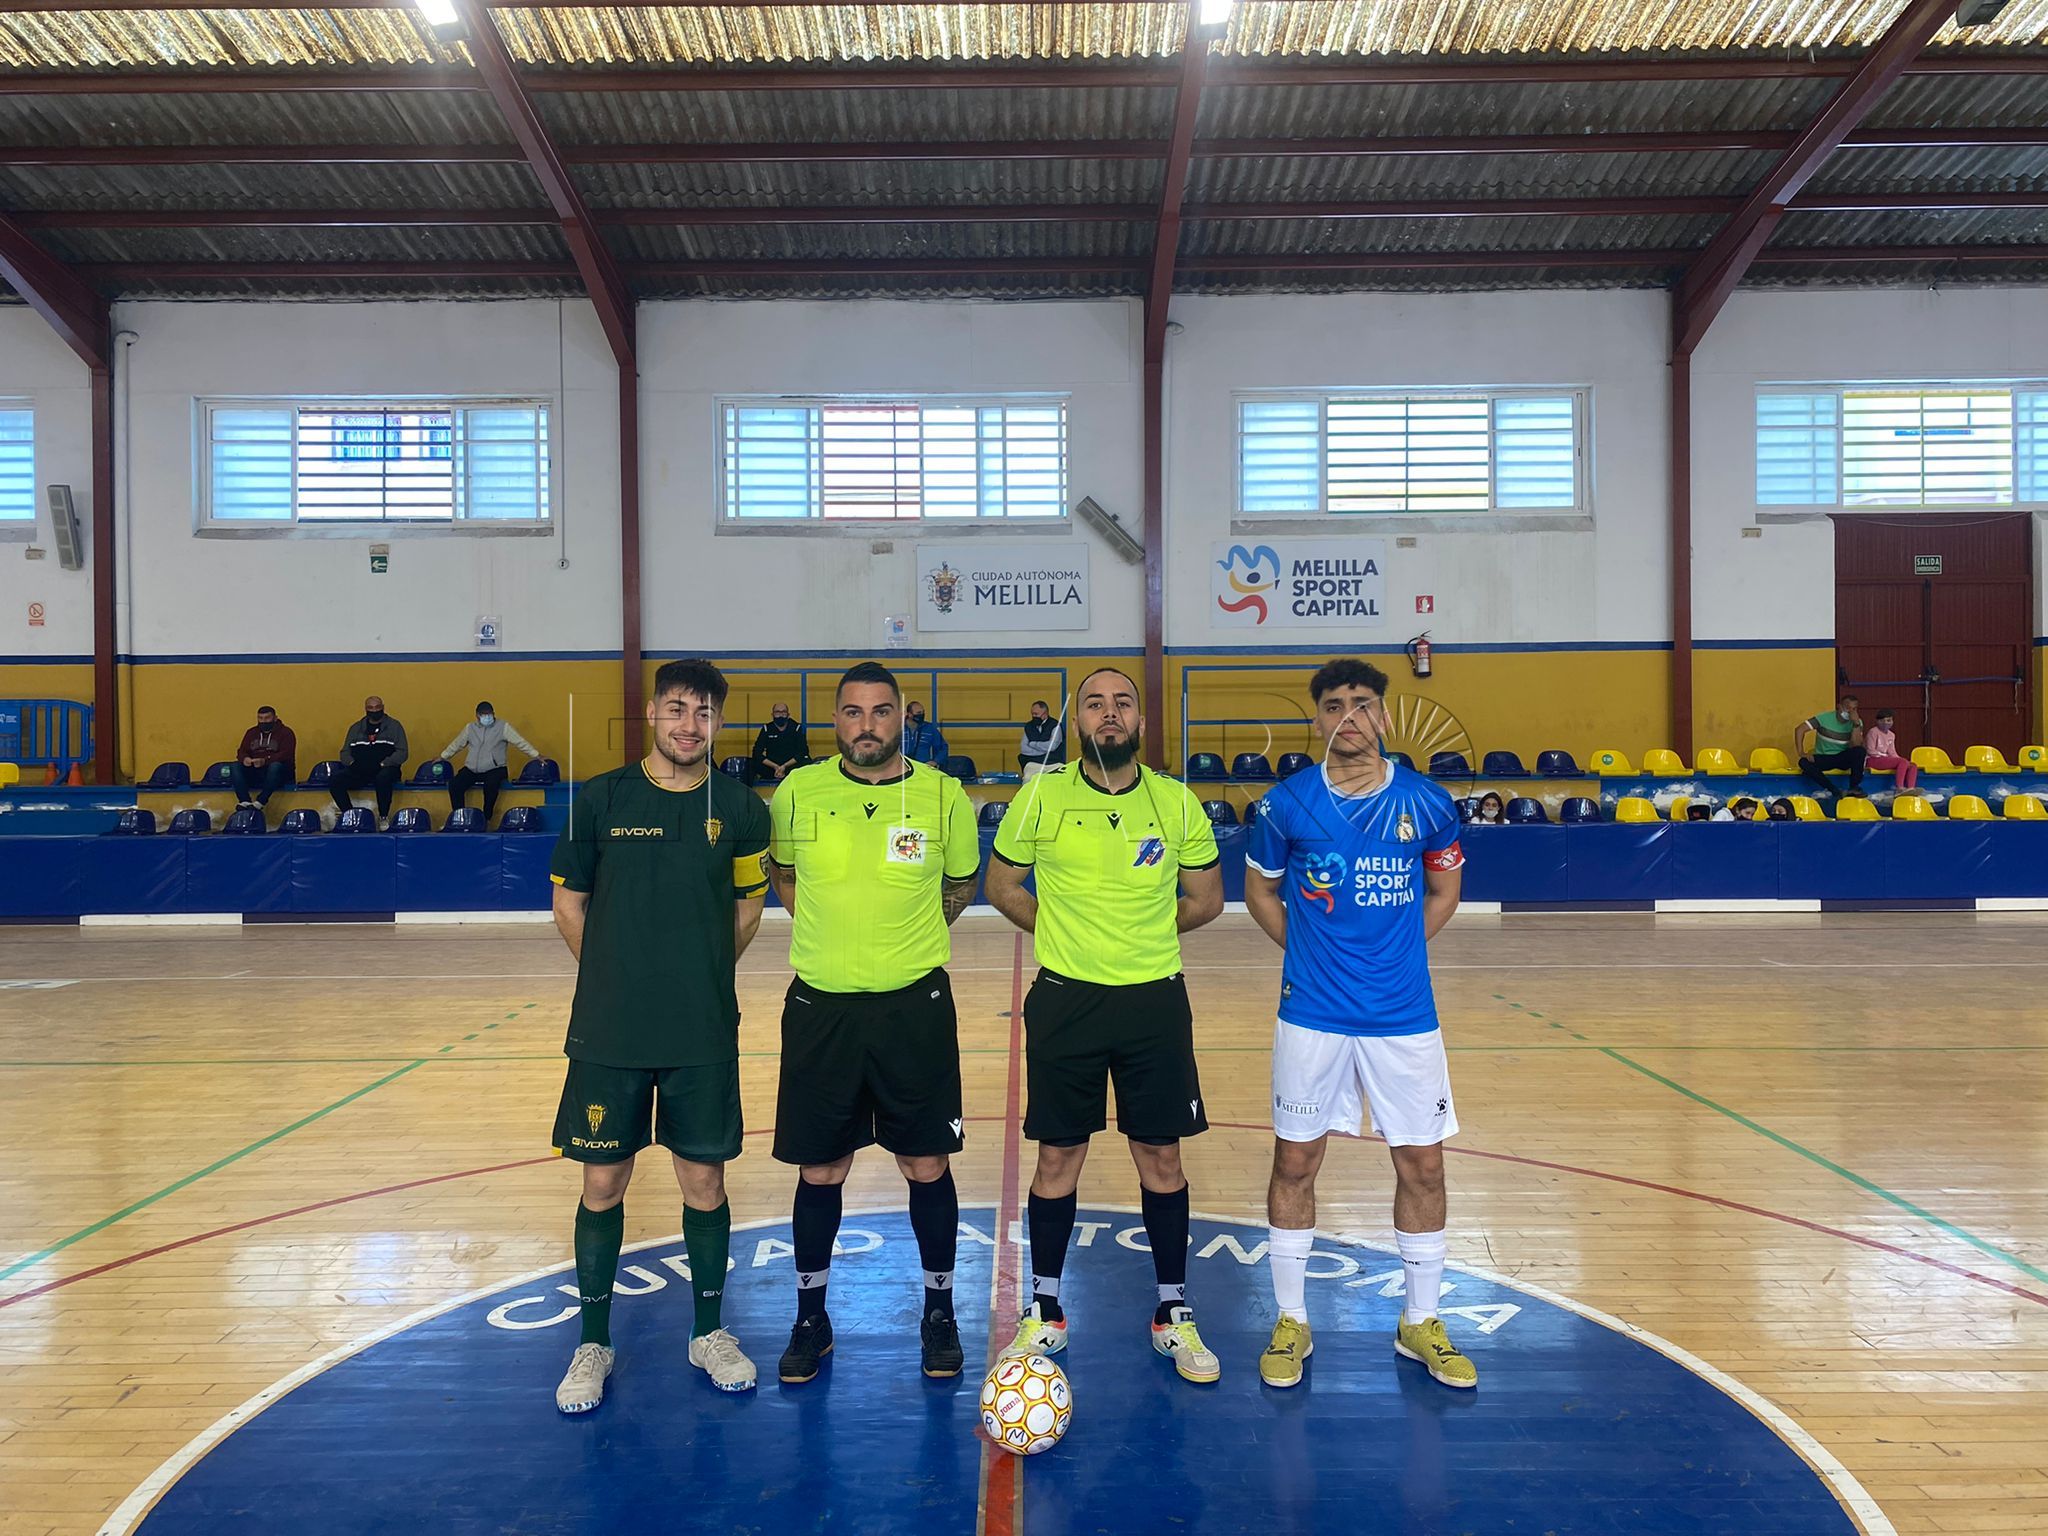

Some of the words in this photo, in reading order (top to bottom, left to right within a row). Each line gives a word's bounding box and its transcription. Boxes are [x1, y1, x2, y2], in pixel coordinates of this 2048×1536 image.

[1292, 559, 1379, 576] MELILLA
[1916, 557, 1940, 566] SALIDA
[971, 571, 1012, 581] CIUDAD
[1015, 570, 1081, 581] AUTÓNOMA
[974, 584, 1082, 605] MELILLA
[1292, 579, 1362, 596] SPORT
[1292, 599, 1379, 616] CAPITAL
[610, 827, 663, 837] GIVOVA
[1354, 873, 1411, 890] SPORT
[571, 1136, 620, 1149] GIVOVA
